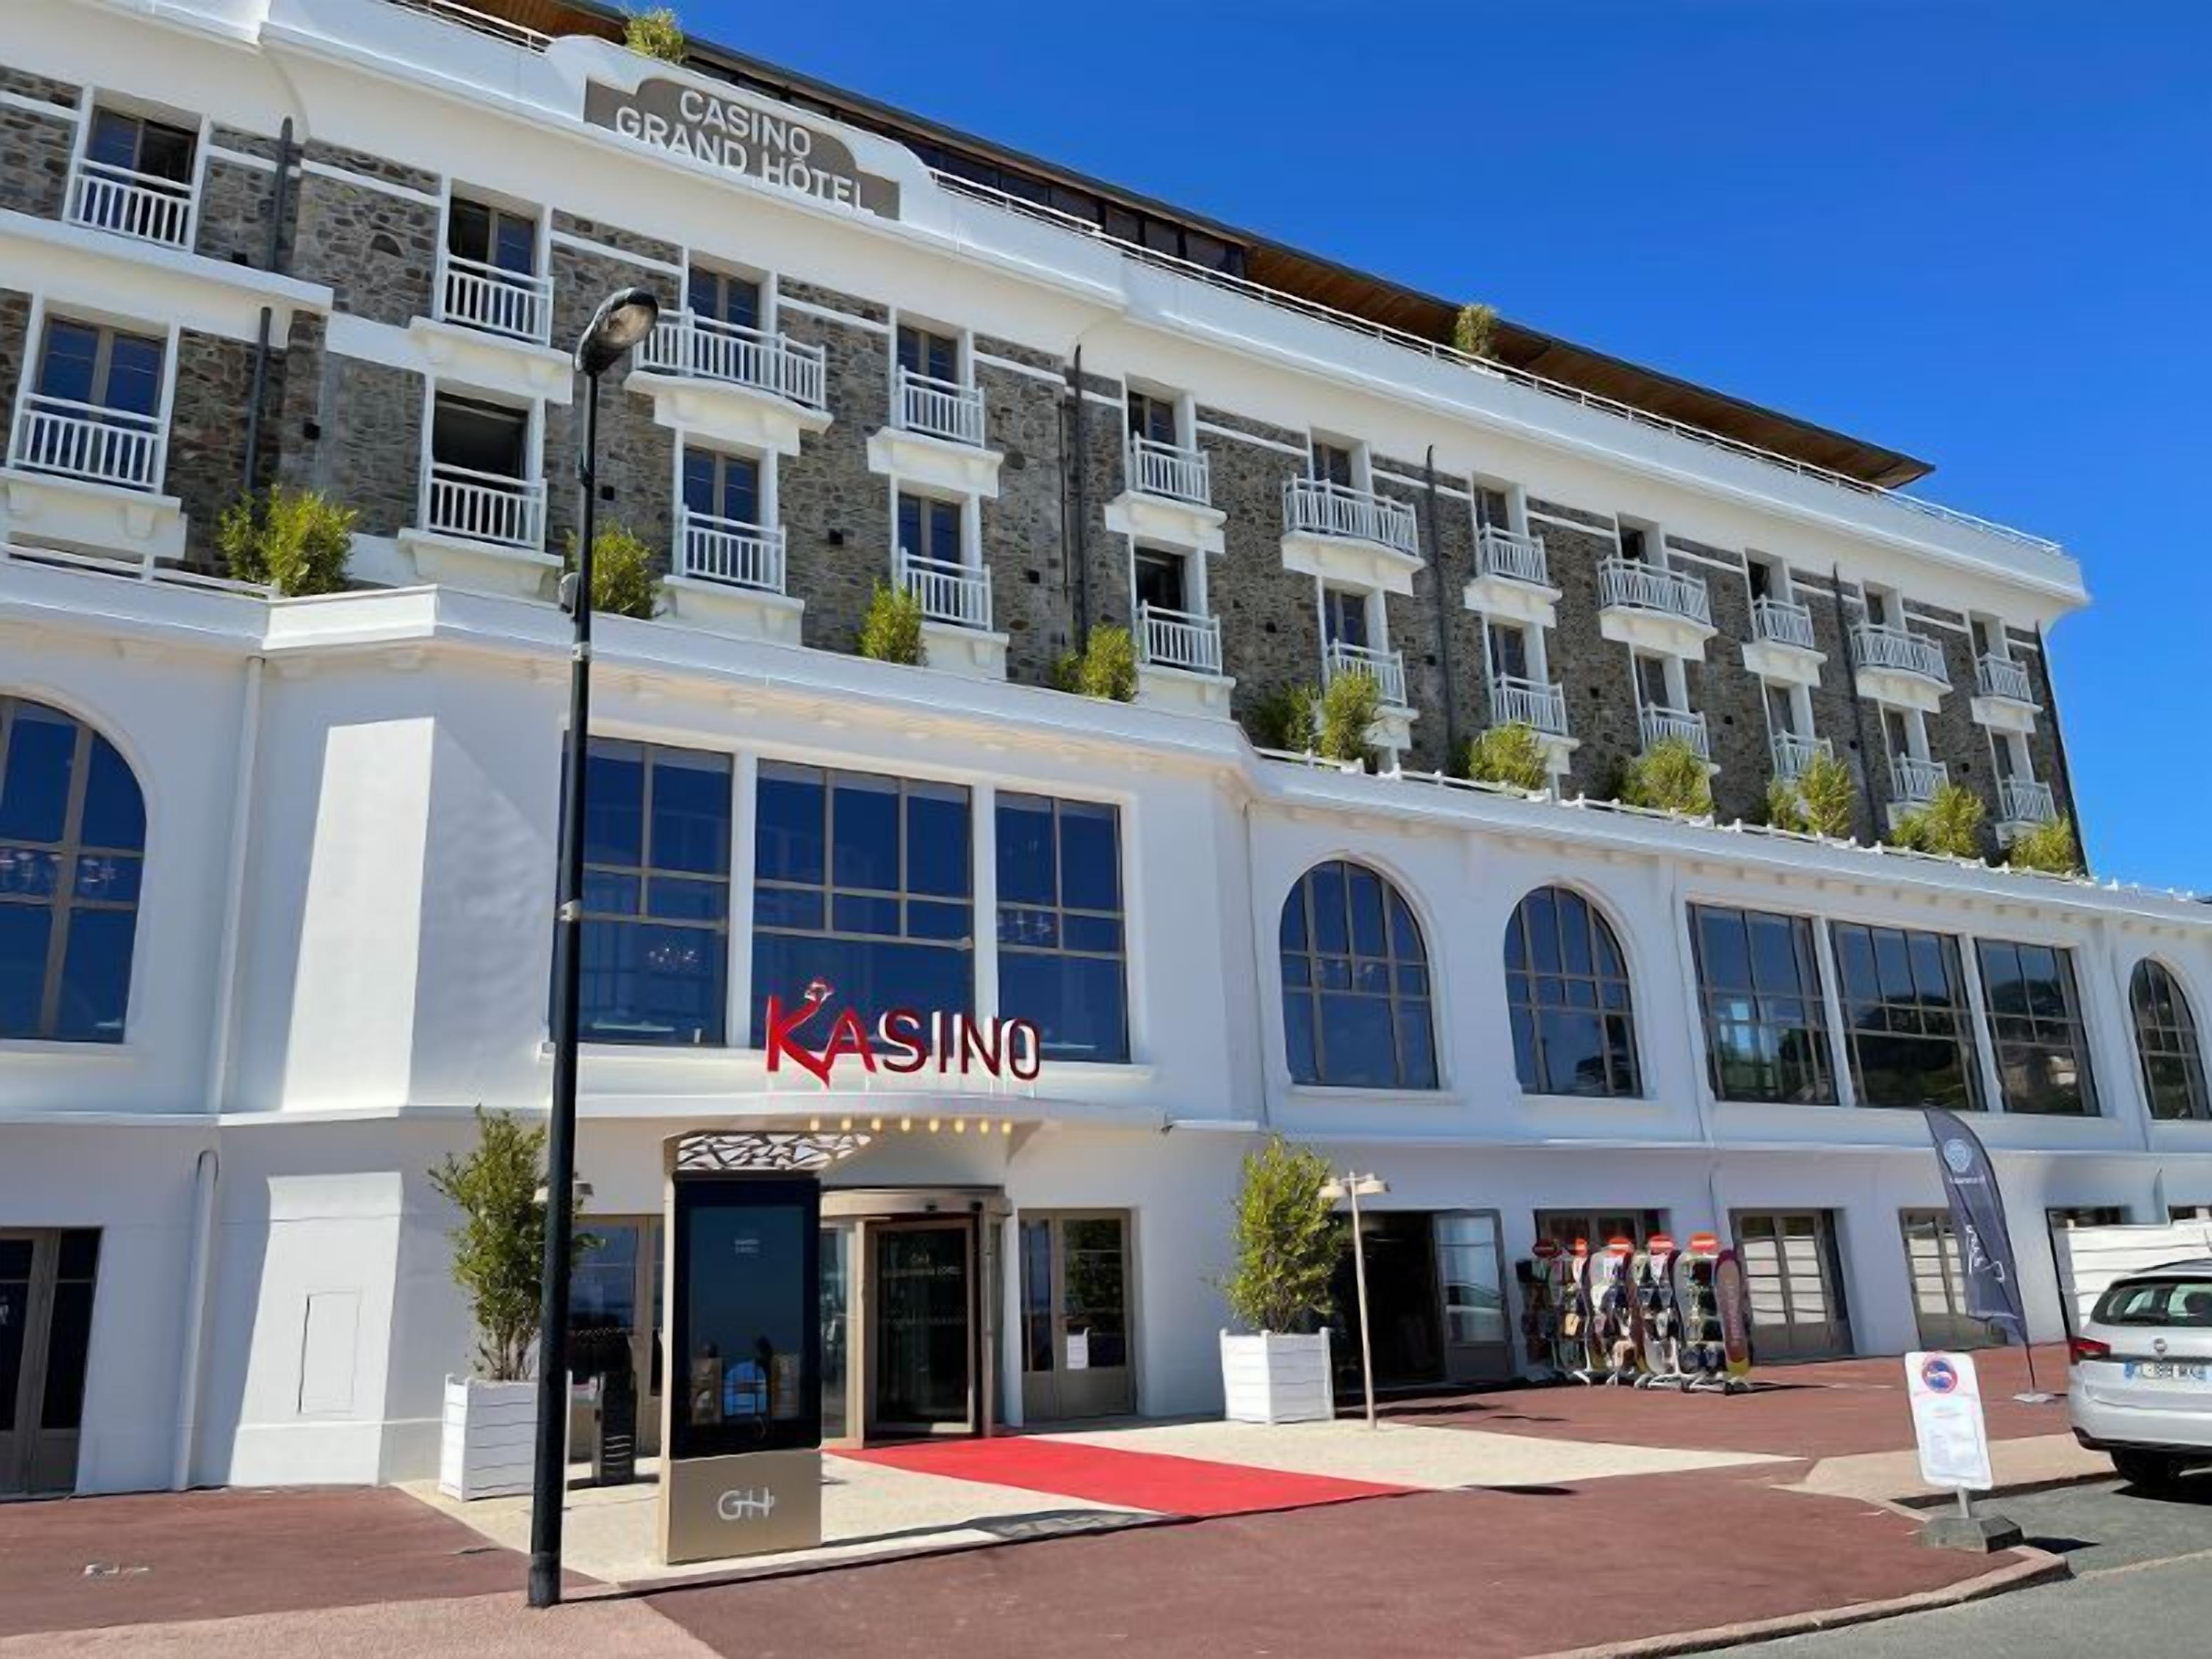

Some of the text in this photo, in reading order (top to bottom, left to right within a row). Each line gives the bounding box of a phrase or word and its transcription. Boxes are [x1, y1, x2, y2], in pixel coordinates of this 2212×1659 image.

[615, 106, 875, 214] GRAND HÔTEL
[679, 90, 811, 158] CASINO
[765, 979, 1041, 1089] KASINO
[718, 1486, 775, 1520] GH
